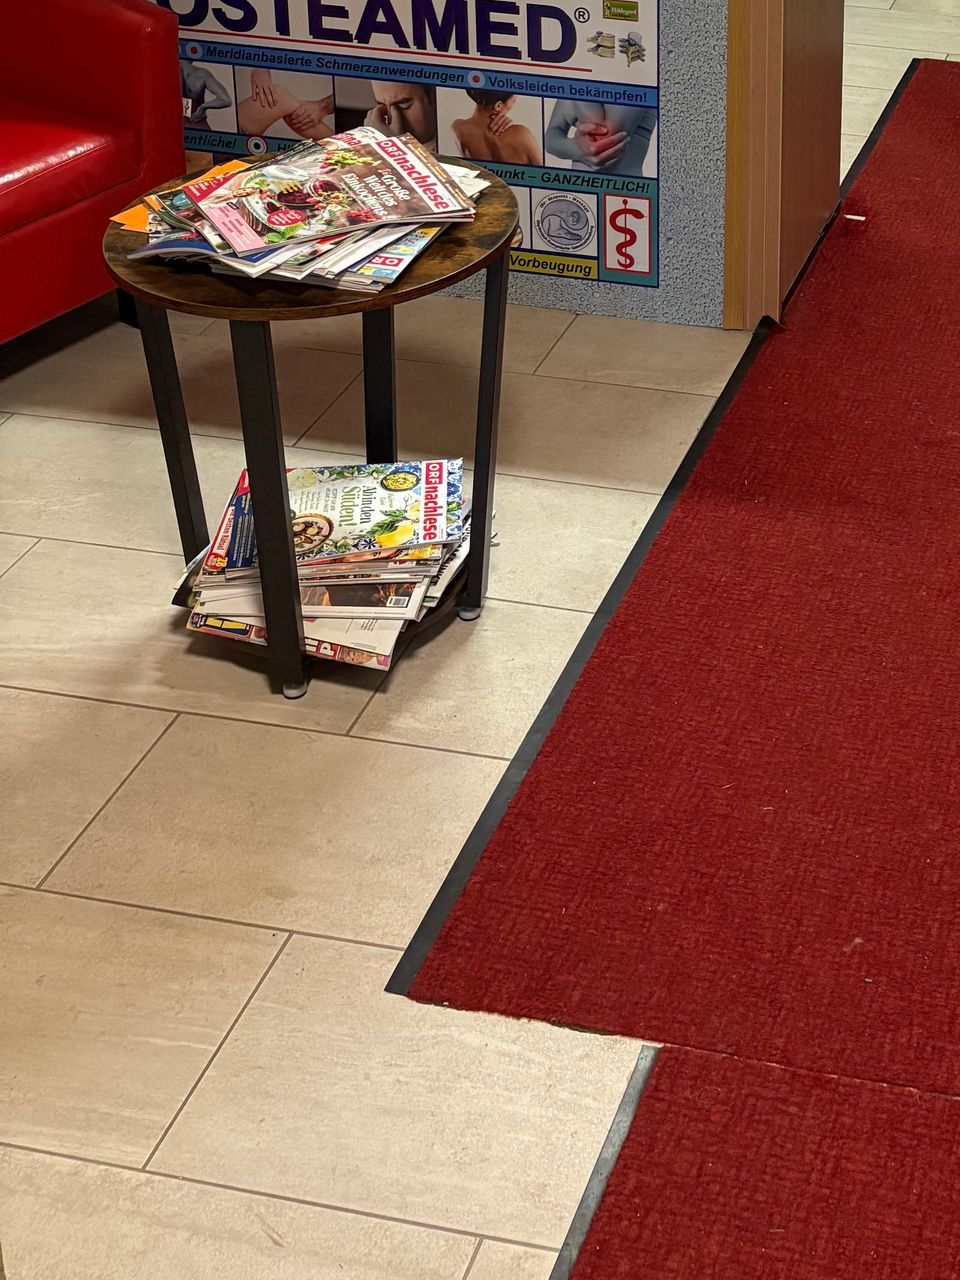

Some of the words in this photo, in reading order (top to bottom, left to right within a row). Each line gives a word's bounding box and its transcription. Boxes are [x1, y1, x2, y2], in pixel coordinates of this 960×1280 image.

[205, 45, 313, 69] Meridianbasierte
[315, 57, 465, 85] Schmerzanwendungen
[488, 76, 565, 95] Volksleiden
[569, 84, 648, 104] bekämpfen!
[541, 174, 650, 194] GANZHEITLICH!
[510, 254, 592, 276] Vorbeugung
[339, 486, 360, 527] Süden!
